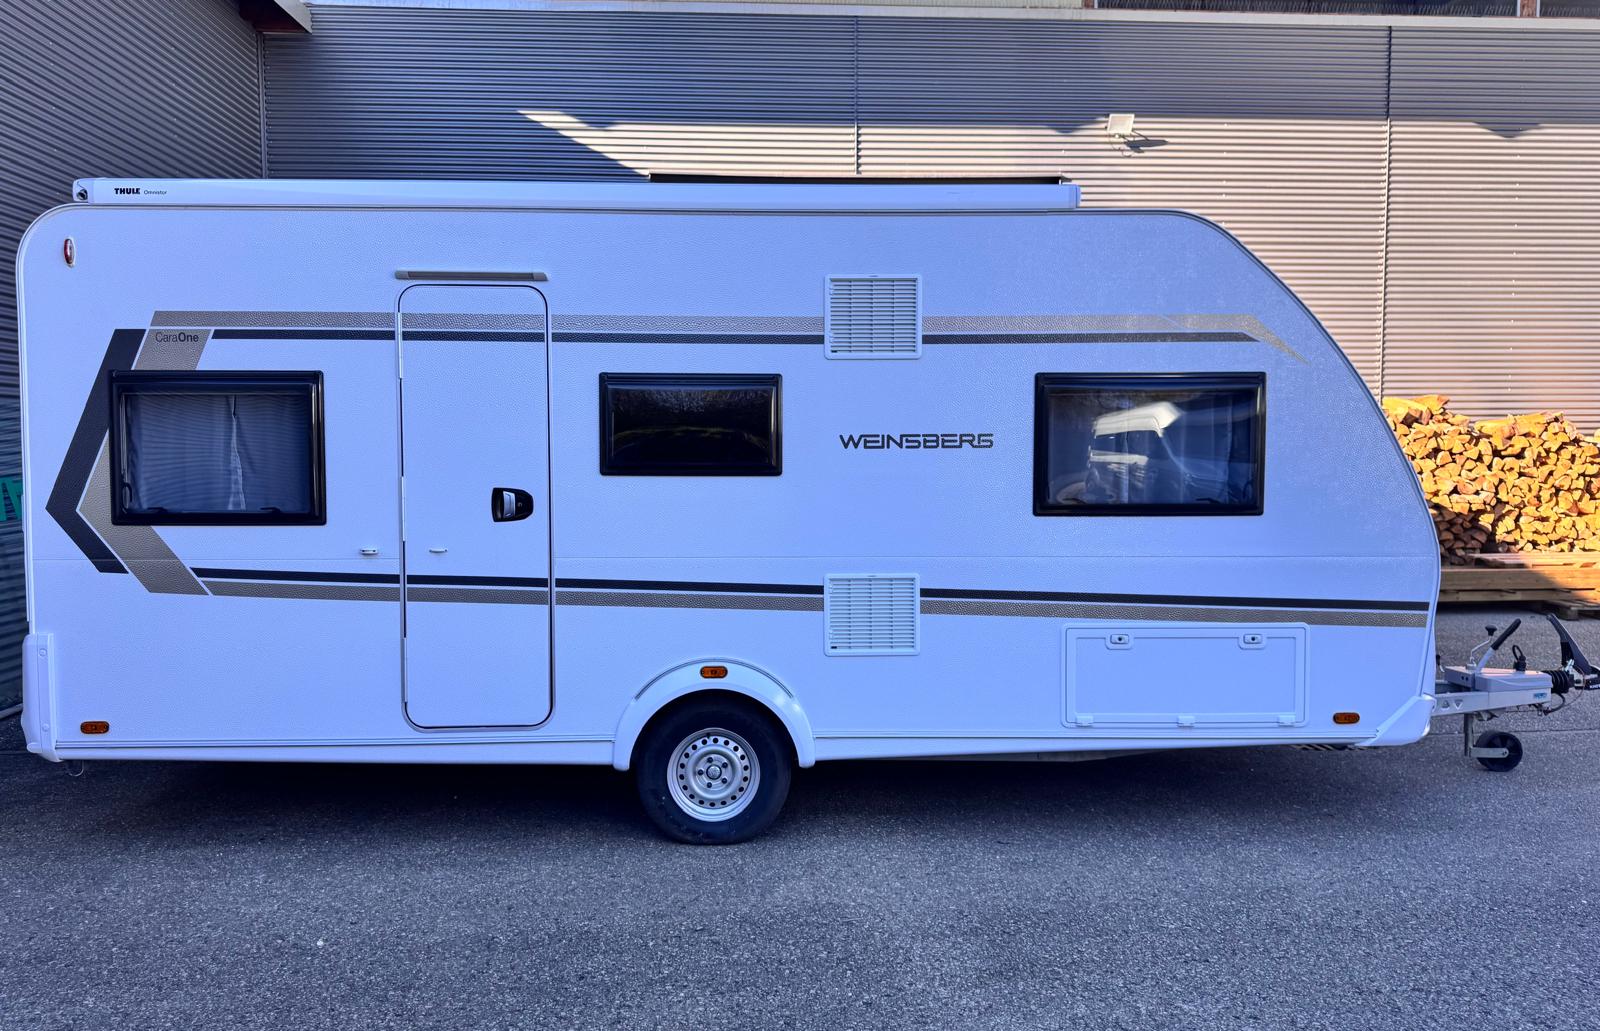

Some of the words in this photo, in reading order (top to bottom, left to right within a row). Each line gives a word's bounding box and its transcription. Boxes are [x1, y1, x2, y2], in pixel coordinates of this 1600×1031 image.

[114, 187, 141, 195] THULE
[155, 331, 199, 342] CaraOne
[839, 433, 994, 449] WEINSBERG
